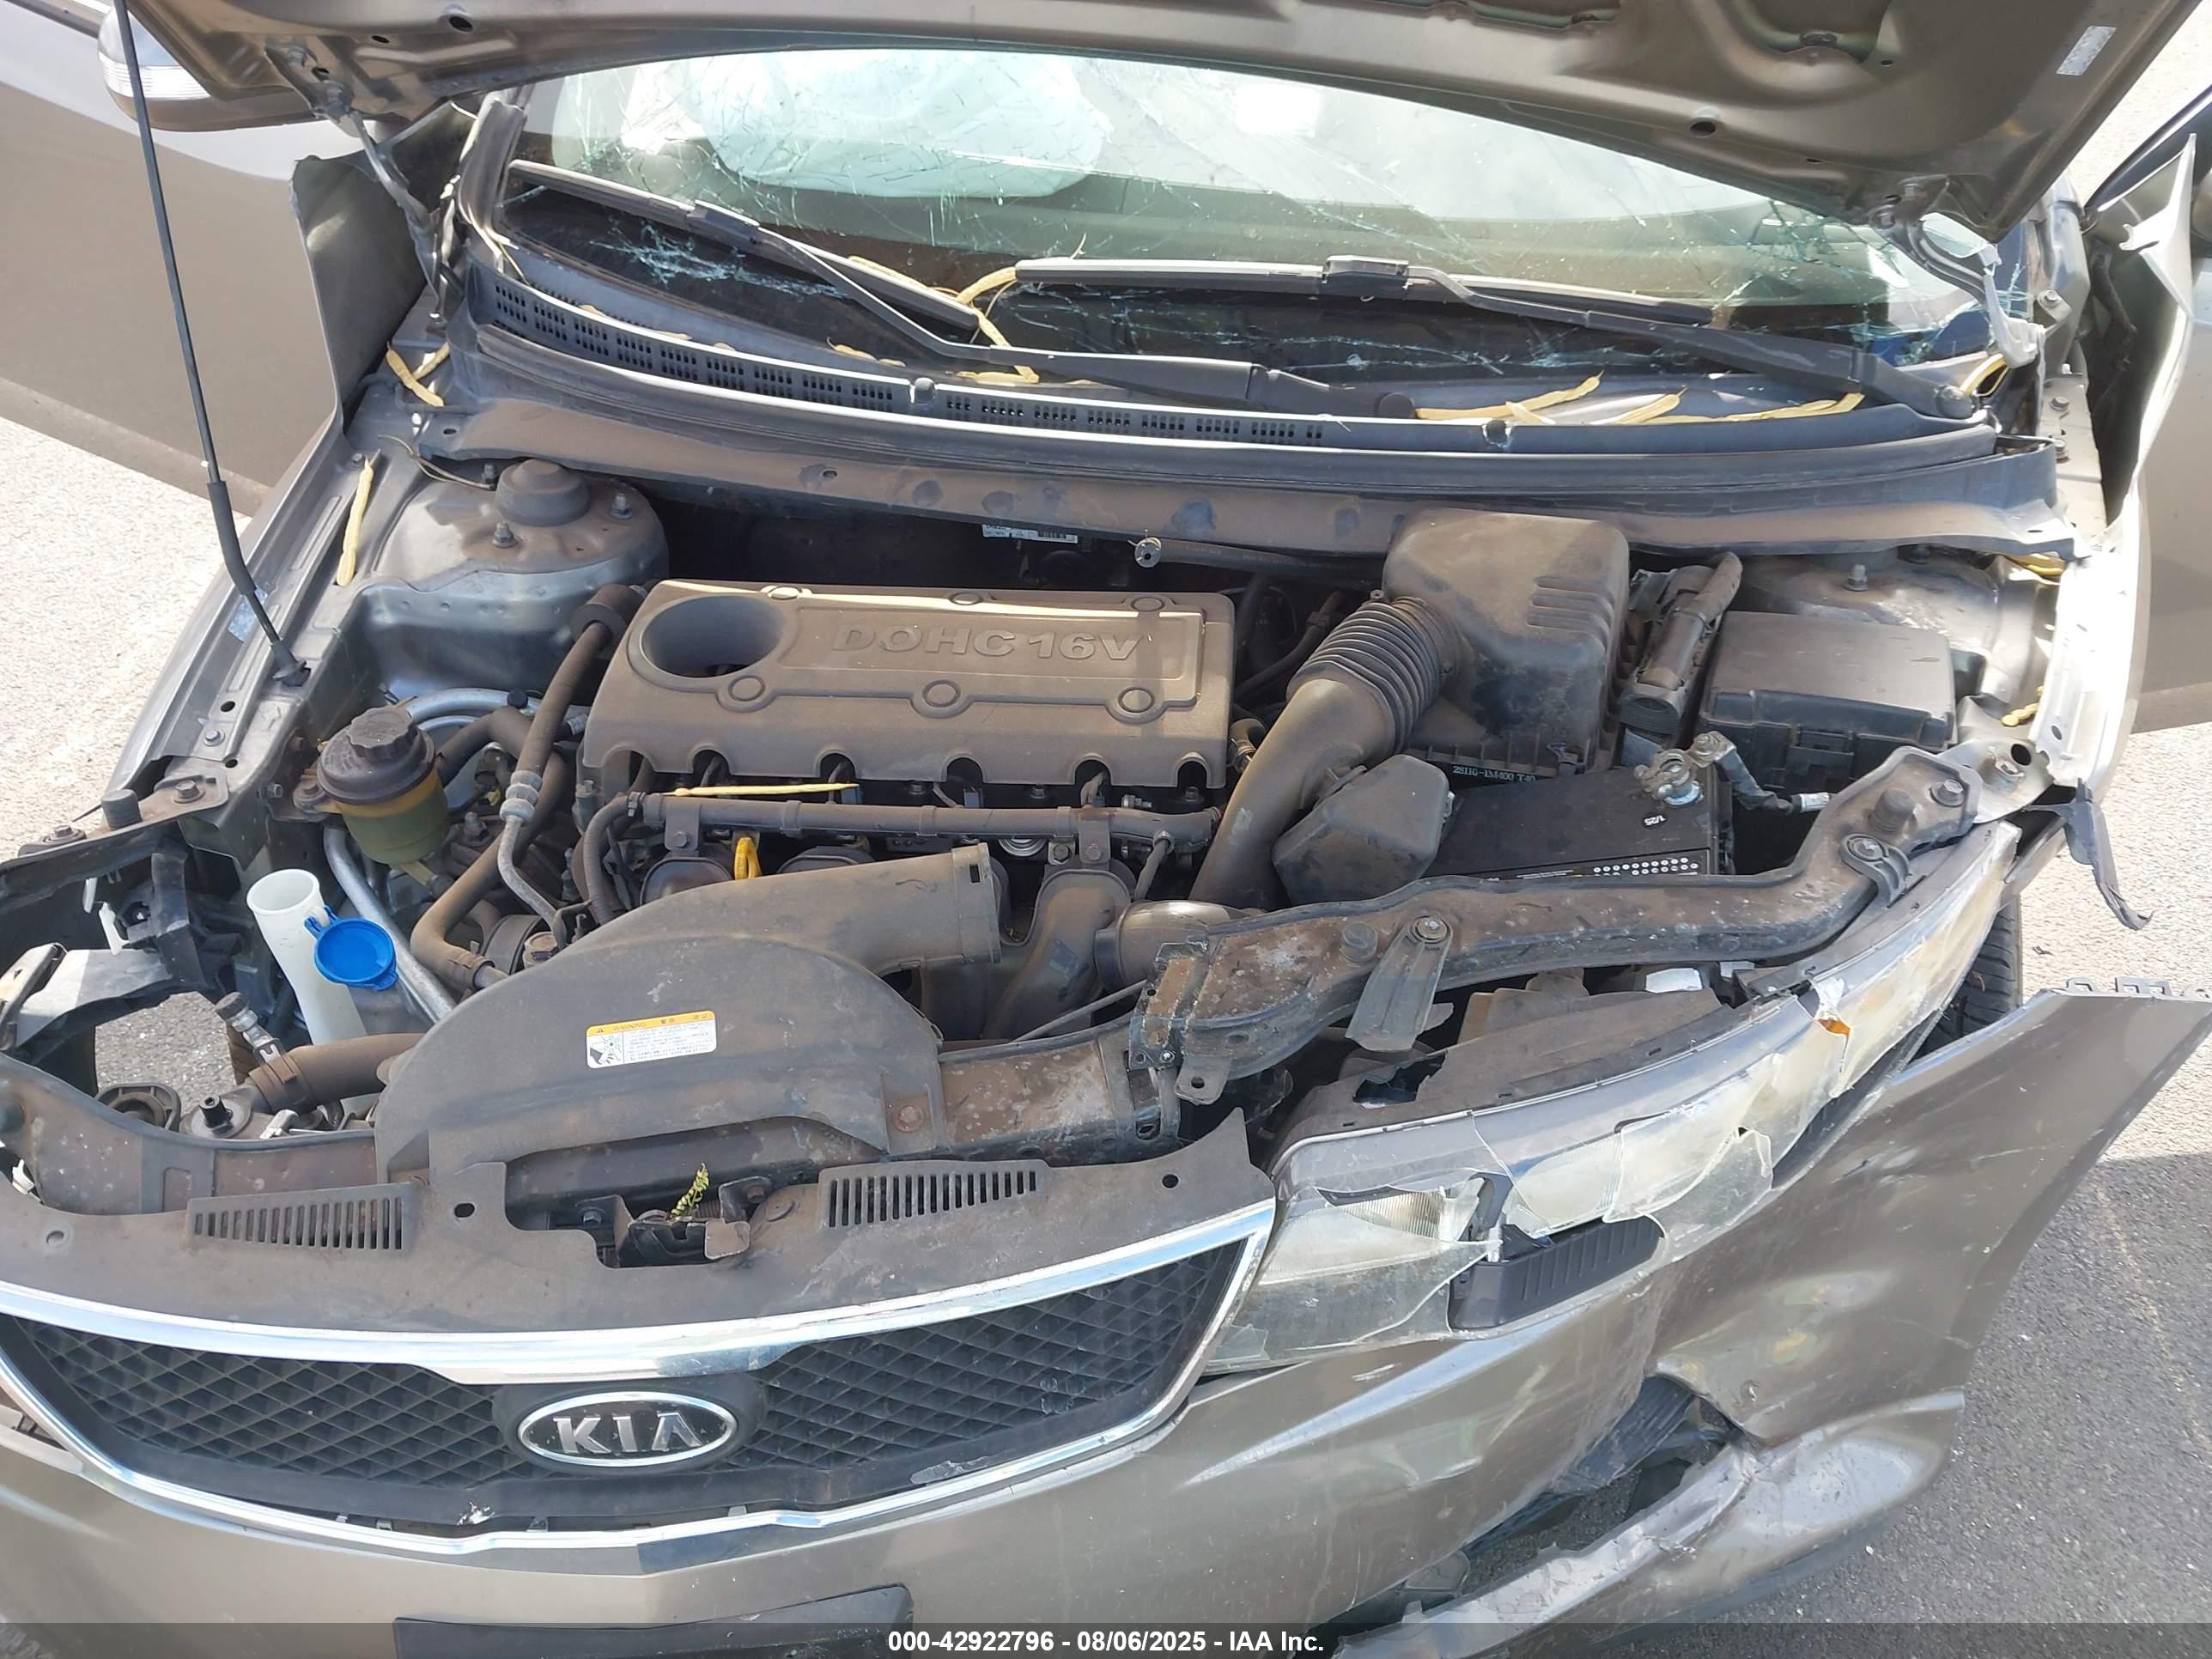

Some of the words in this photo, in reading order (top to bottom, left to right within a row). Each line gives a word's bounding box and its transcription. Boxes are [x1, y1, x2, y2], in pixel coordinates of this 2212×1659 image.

[832, 624, 1016, 656] DOHC
[1029, 631, 1142, 660] 16V
[553, 1412, 702, 1454] KIA
